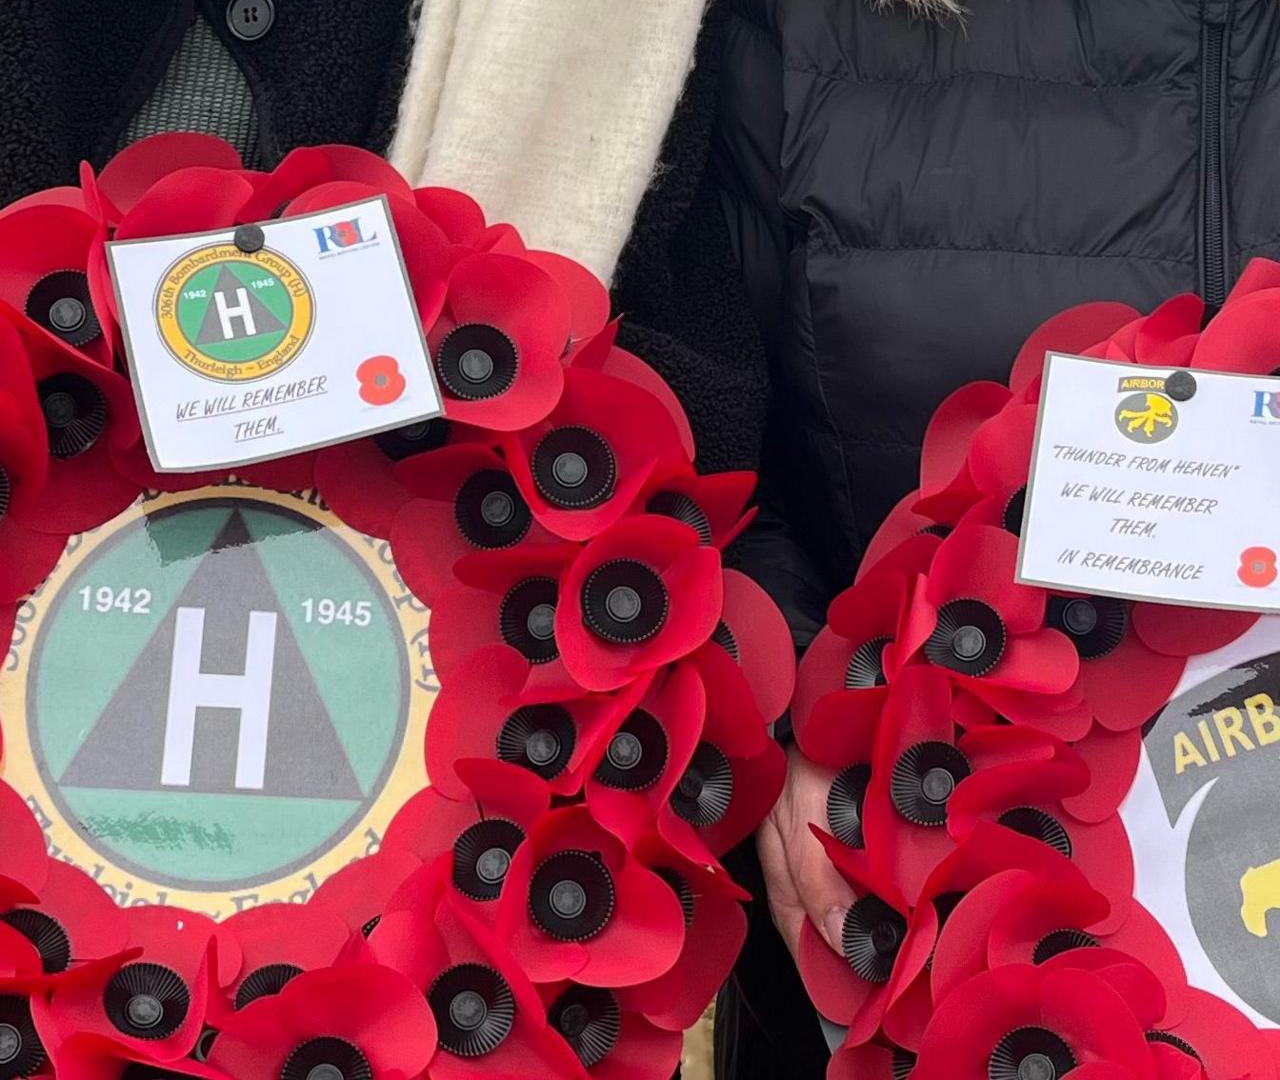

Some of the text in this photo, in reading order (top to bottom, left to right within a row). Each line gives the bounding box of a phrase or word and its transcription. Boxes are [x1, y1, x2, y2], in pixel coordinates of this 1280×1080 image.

[161, 287, 174, 319] 306th
[170, 248, 251, 285] Bombardmen
[256, 251, 291, 279] Group
[183, 290, 207, 300] 1942
[251, 278, 275, 289] 1945
[214, 288, 256, 340] H
[184, 349, 242, 378] Thurleigh
[256, 335, 301, 370] England
[176, 375, 327, 419] WE WILL REMEMBER
[1122, 378, 1166, 390] AIRBOR
[234, 416, 280, 440] THEM.
[1053, 444, 1240, 479] "THUNDER FROM HEAVEN"
[1060, 482, 1218, 515] WE WILL REMEMBER
[1110, 518, 1157, 539] THEM.
[1057, 548, 1205, 581] IN REMEMBRANCE
[78, 586, 151, 614] 1942
[301, 598, 372, 626] 1945
[160, 607, 277, 789] H
